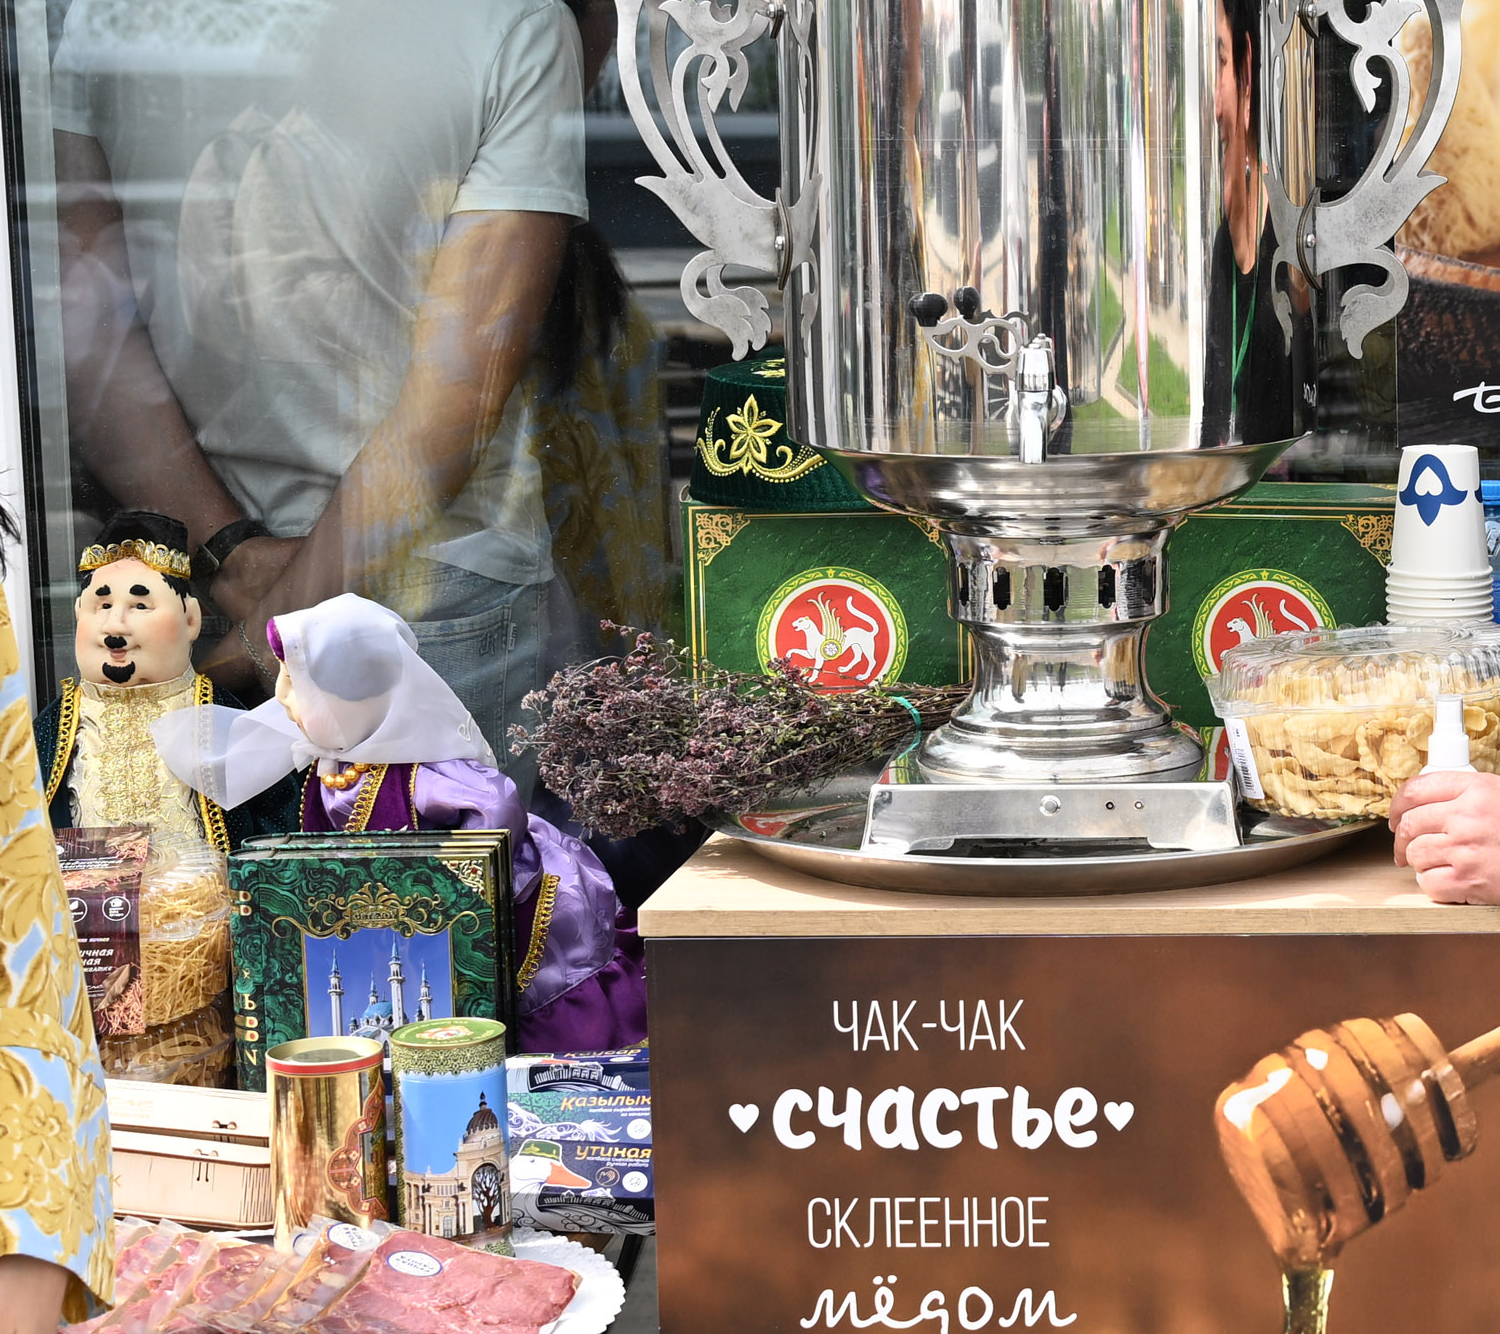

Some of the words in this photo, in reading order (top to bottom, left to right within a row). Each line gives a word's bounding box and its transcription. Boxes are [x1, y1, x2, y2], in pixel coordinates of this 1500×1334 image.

[834, 1000, 1025, 1051] ЧАК-ЧАК
[772, 1086, 1099, 1151] счастье
[808, 1197, 1049, 1248] СКЛЕЕННОЕ
